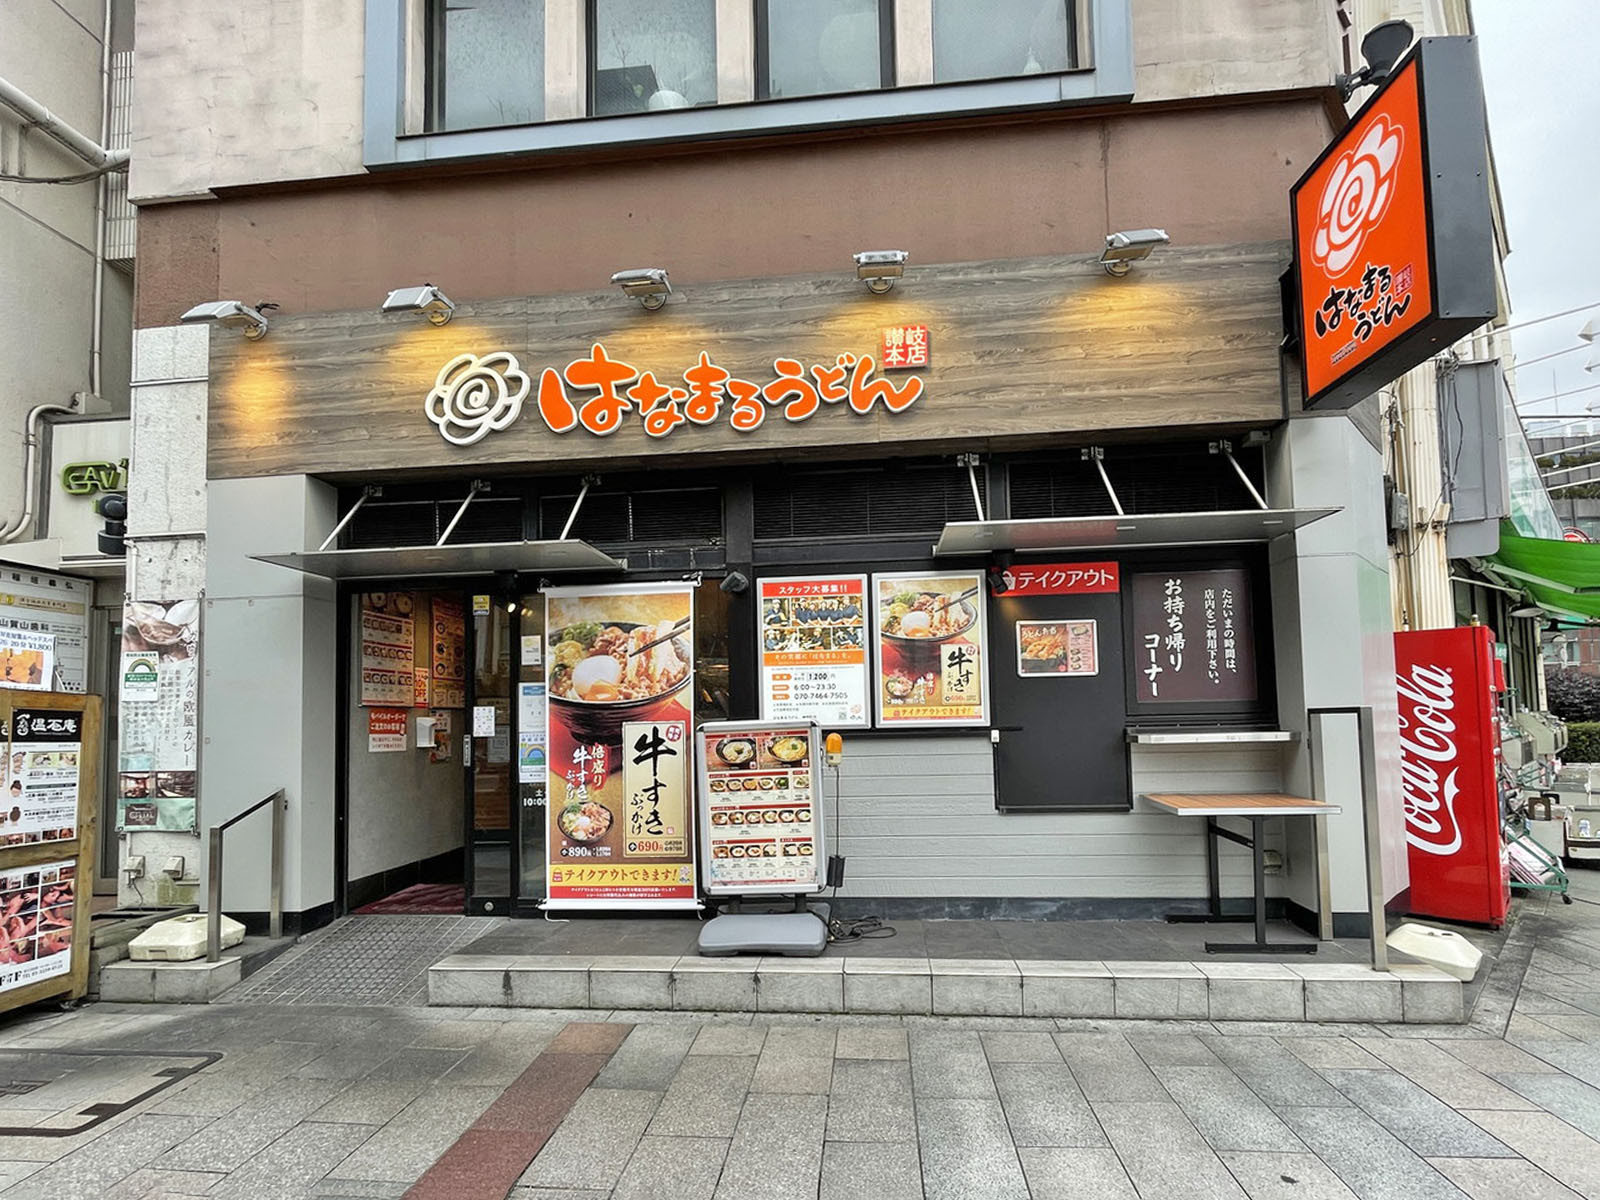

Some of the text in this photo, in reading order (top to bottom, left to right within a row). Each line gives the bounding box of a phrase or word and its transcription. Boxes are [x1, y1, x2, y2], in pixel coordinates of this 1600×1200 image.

[1314, 262, 1392, 338] はなまる
[1353, 294, 1413, 343] うどん
[885, 344, 926, 365] 本店
[537, 341, 925, 438] はなまるうどん
[1018, 569, 1115, 590] テイクアウト
[1163, 579, 1187, 672] お持ち帰り
[1204, 588, 1220, 685] 店内をご利用下さい。
[1222, 588, 1238, 673] ただいまの時間は、
[946, 646, 974, 693] 牛すき
[1143, 633, 1164, 697] コーナー
[572, 745, 593, 801] 牛すき
[632, 725, 678, 836] 牛すき
[630, 793, 645, 836] ぶっかけ
[564, 868, 677, 882] テイクアウトできます!
